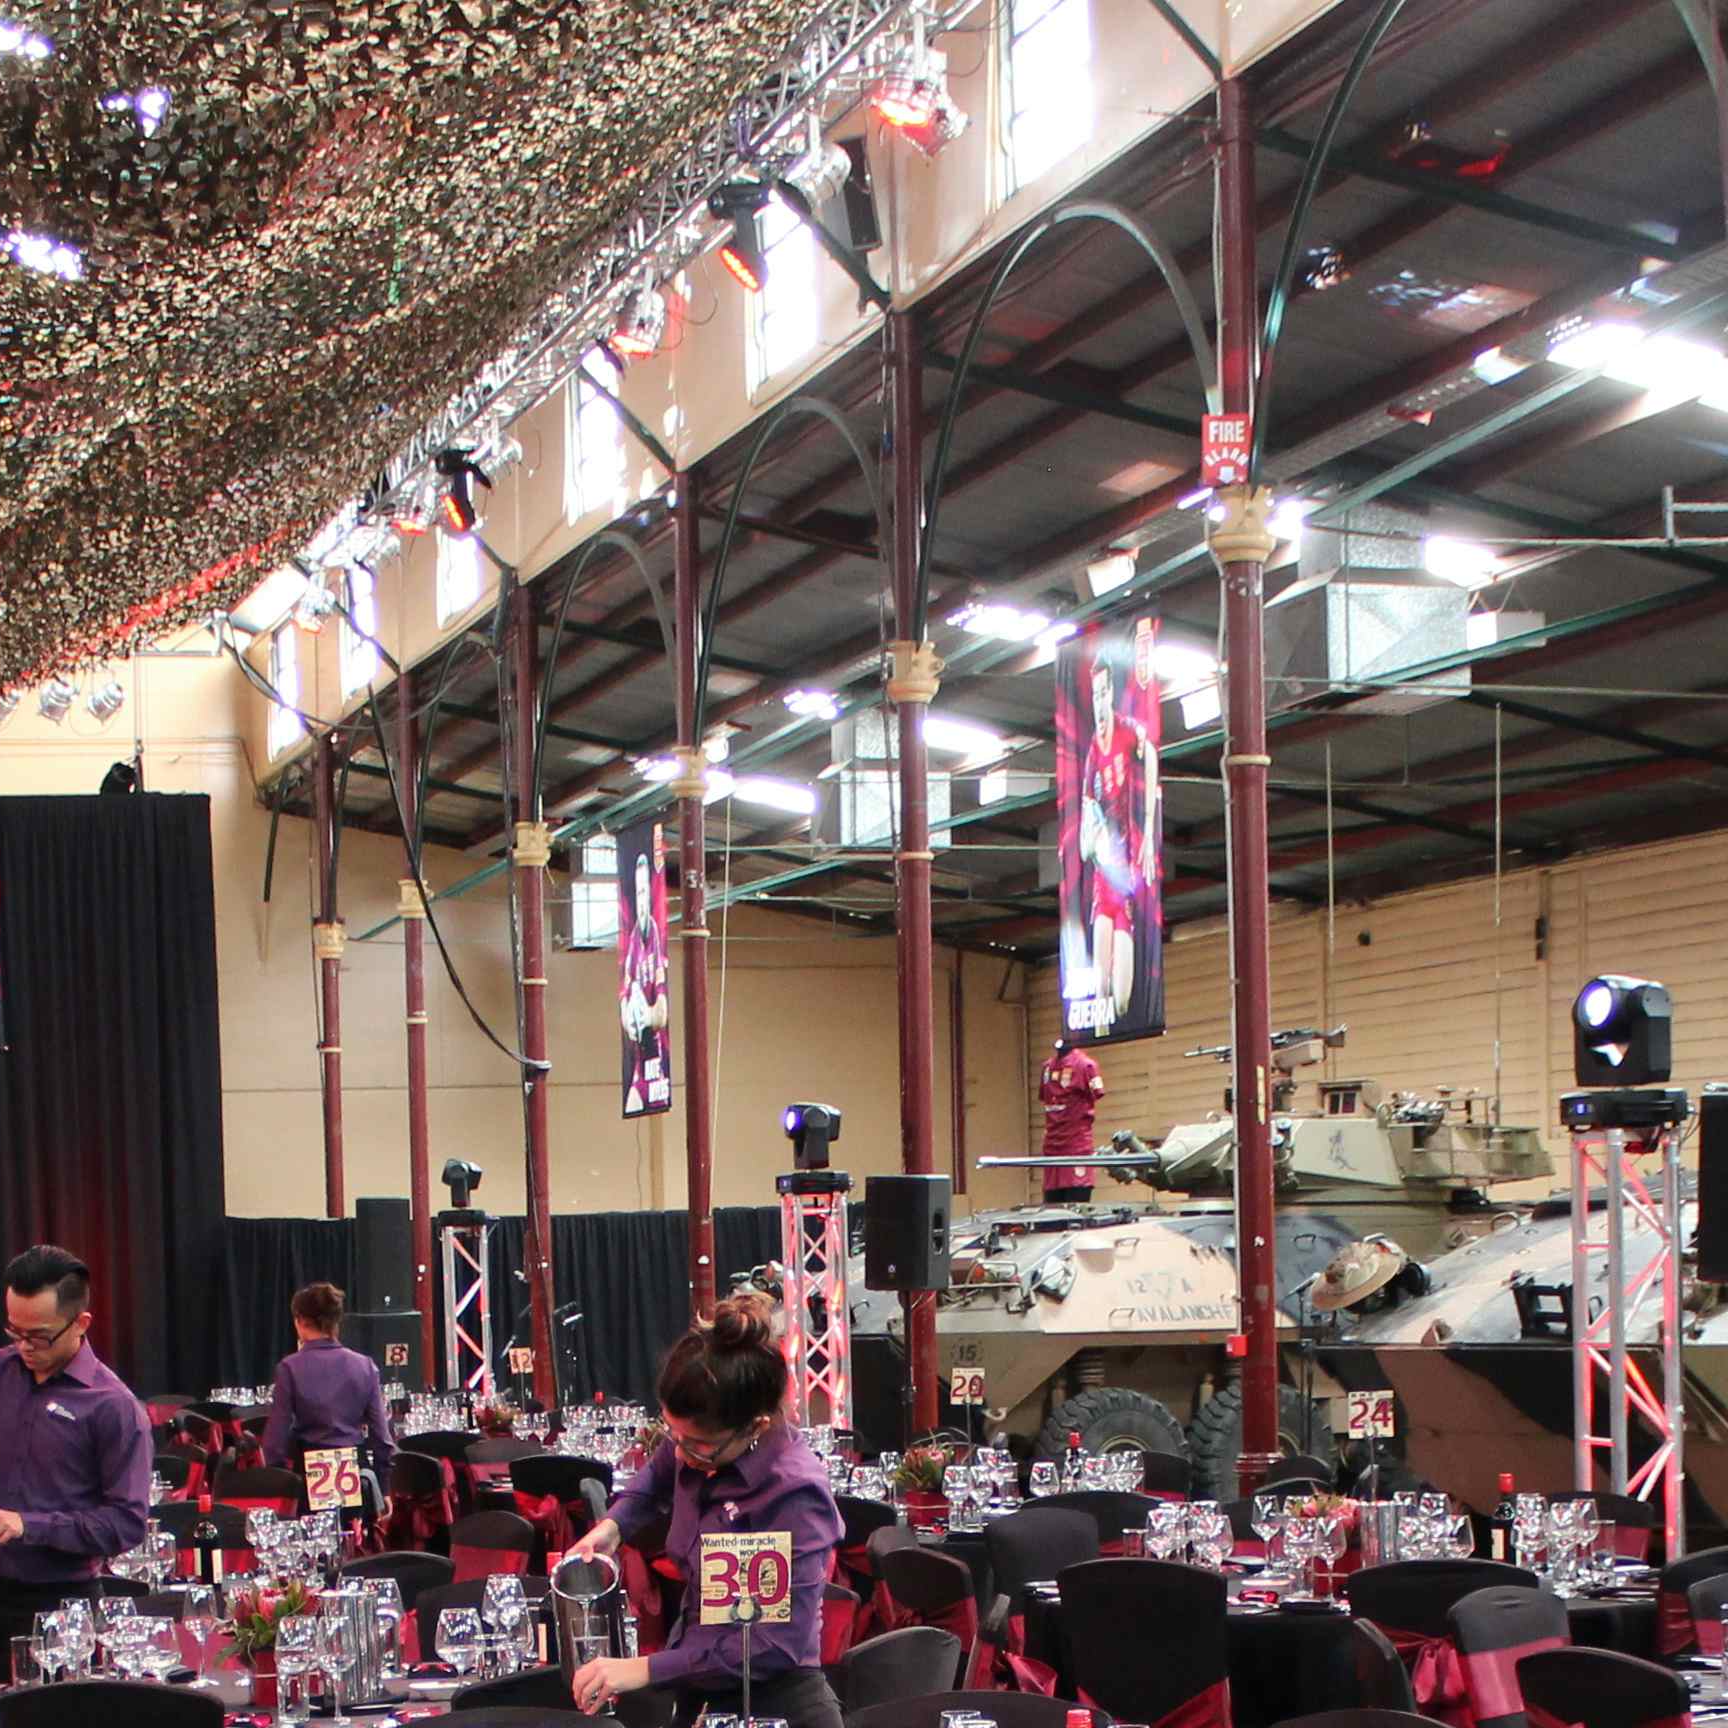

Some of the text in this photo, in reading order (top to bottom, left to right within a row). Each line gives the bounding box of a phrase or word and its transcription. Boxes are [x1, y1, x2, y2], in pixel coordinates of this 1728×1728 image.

[1209, 420, 1246, 443] FIRE
[1204, 447, 1250, 467] ALARM
[390, 1345, 404, 1364] 8
[953, 1374, 984, 1398] 20
[1350, 1399, 1392, 1429] 24
[308, 1460, 360, 1498] 26
[703, 1551, 789, 1607] 30
